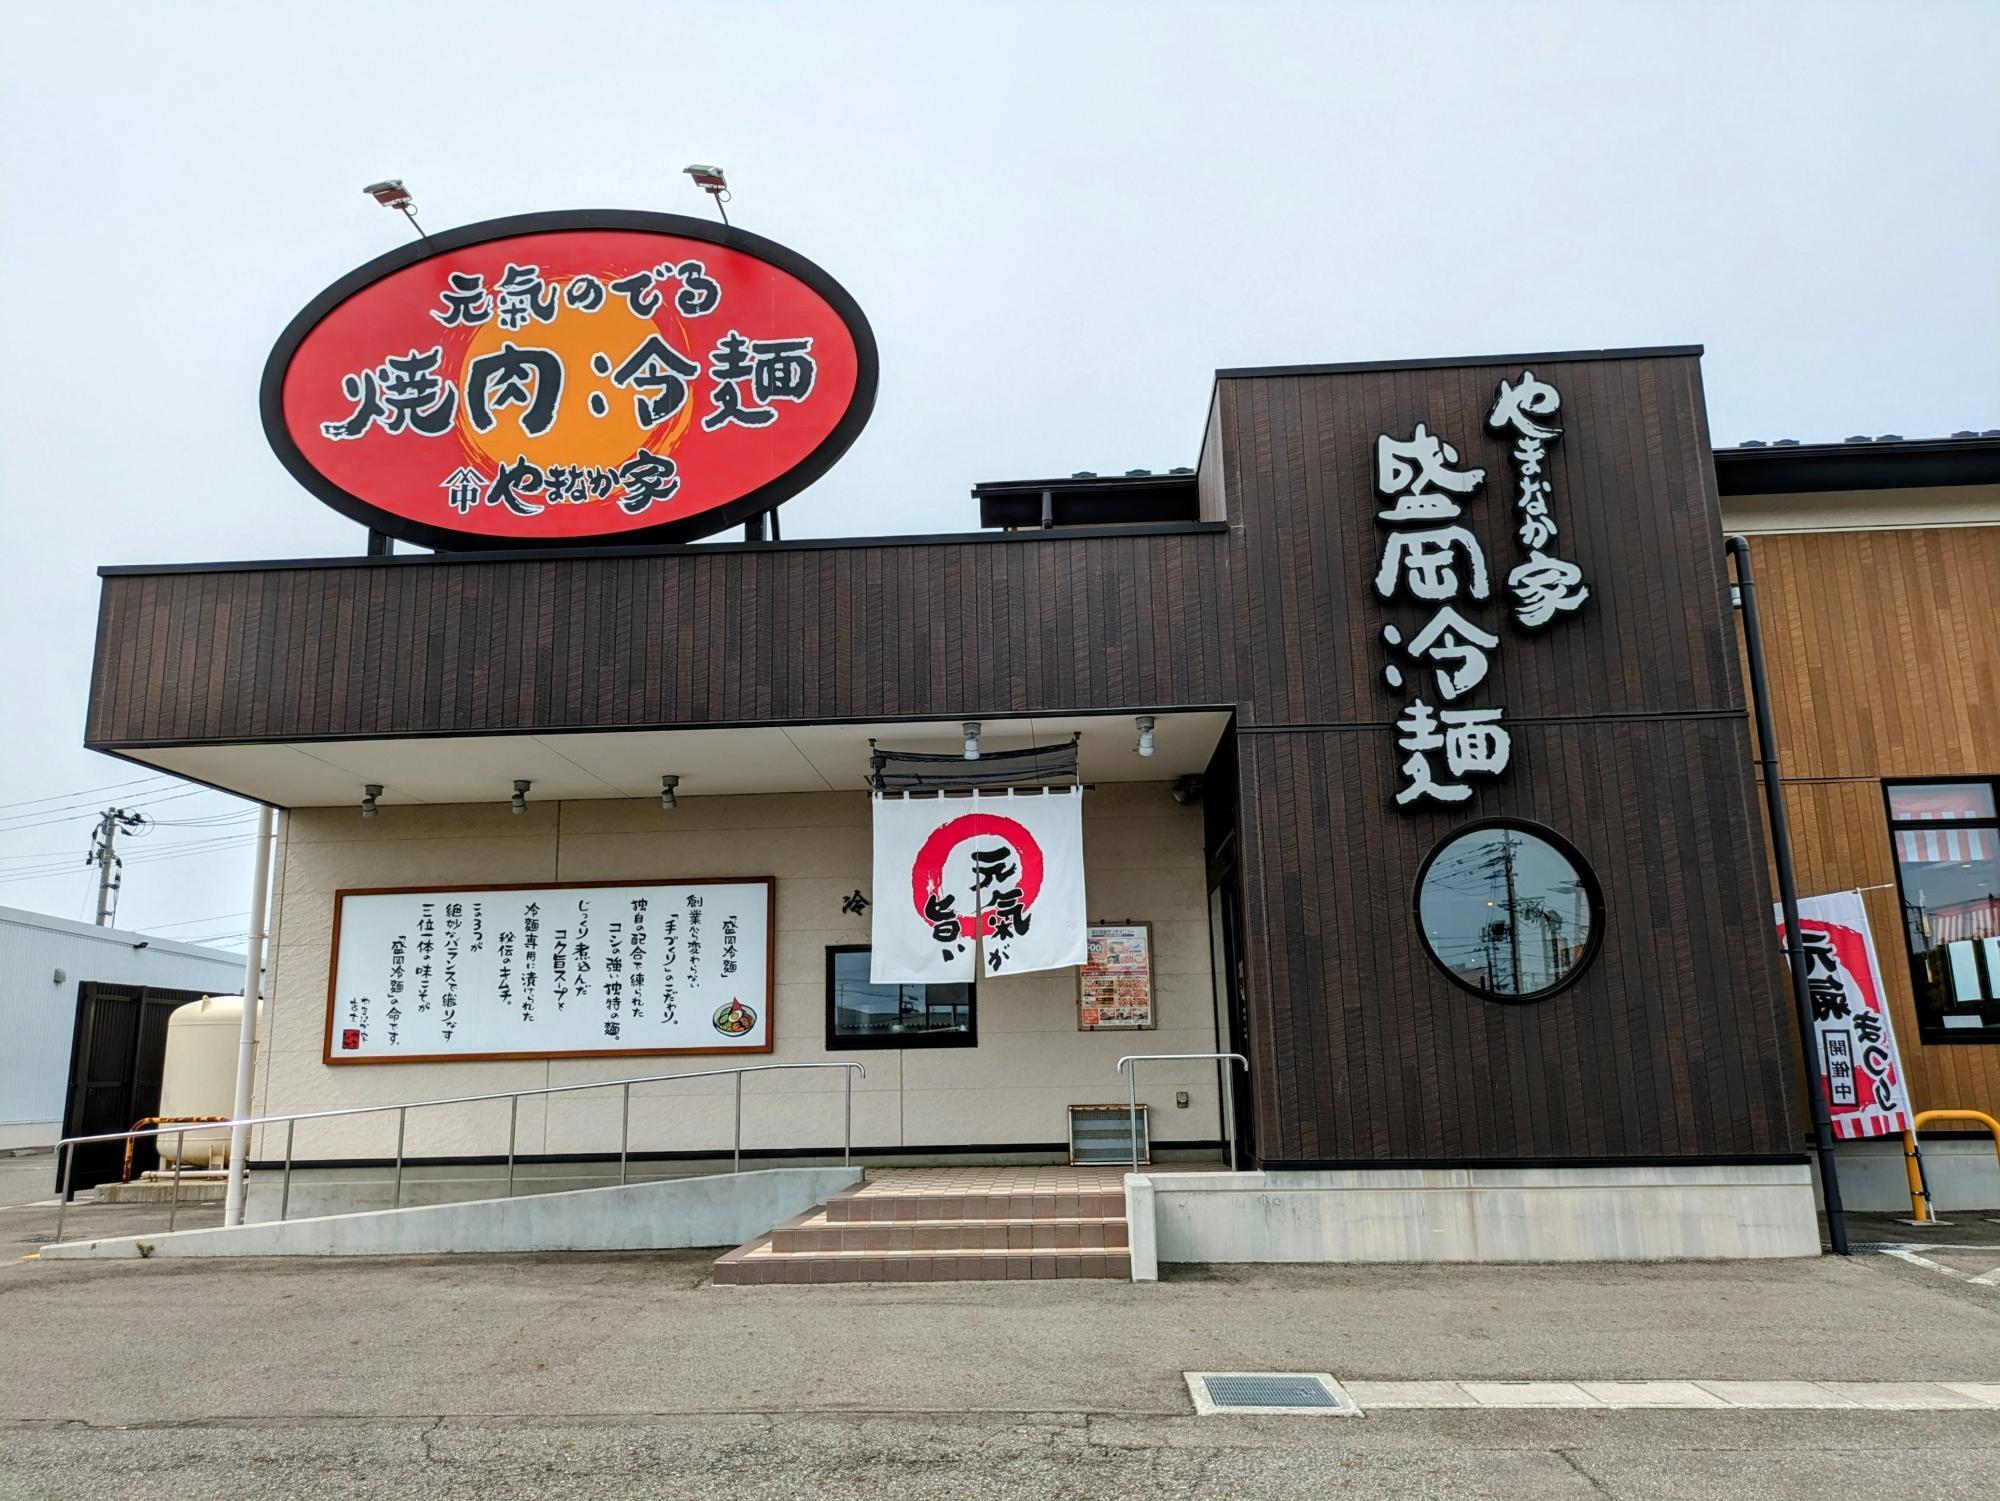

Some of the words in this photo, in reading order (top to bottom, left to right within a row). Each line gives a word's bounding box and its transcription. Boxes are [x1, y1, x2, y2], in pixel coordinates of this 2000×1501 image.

[486, 448, 680, 516] やまなか家
[1490, 370, 1590, 626] やまなか家
[414, 903, 435, 1013] 三位一体の味こそが
[441, 903, 463, 1043] 絶妙なバランスで織りなす
[552, 929, 568, 1011] コク旨スープと
[571, 898, 592, 997] じっくり煮込んだ
[629, 897, 649, 1019] 独自の配合で練られた
[685, 894, 704, 989] 創業から変わらない
[924, 894, 966, 963] 旨い
